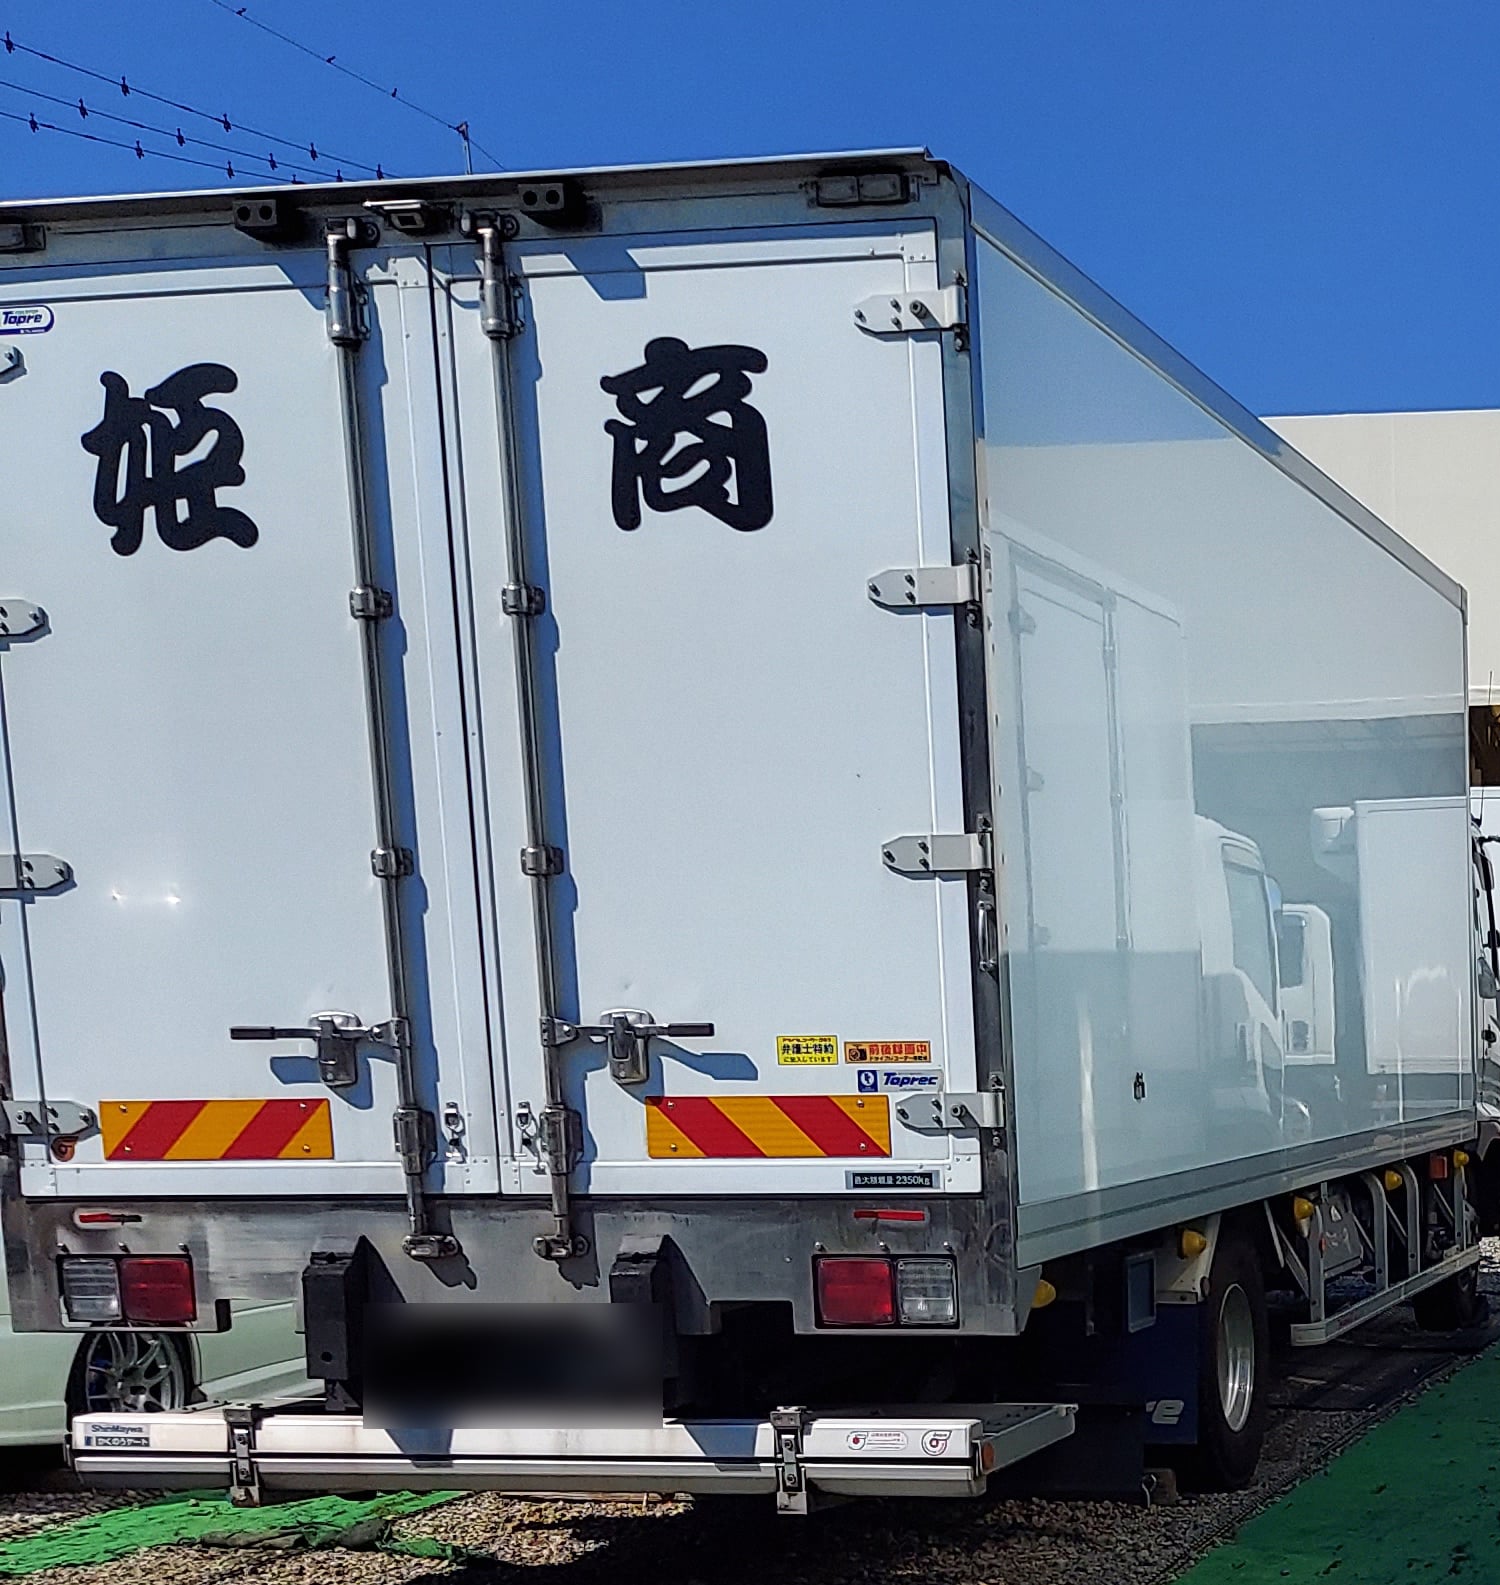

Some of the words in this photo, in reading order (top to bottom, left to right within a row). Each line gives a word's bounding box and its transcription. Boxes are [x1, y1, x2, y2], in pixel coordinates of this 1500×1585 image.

[2, 310, 43, 326] Topre
[600, 337, 773, 531] 商
[883, 1072, 938, 1087] Toprec
[896, 1175, 931, 1186] 2350kg
